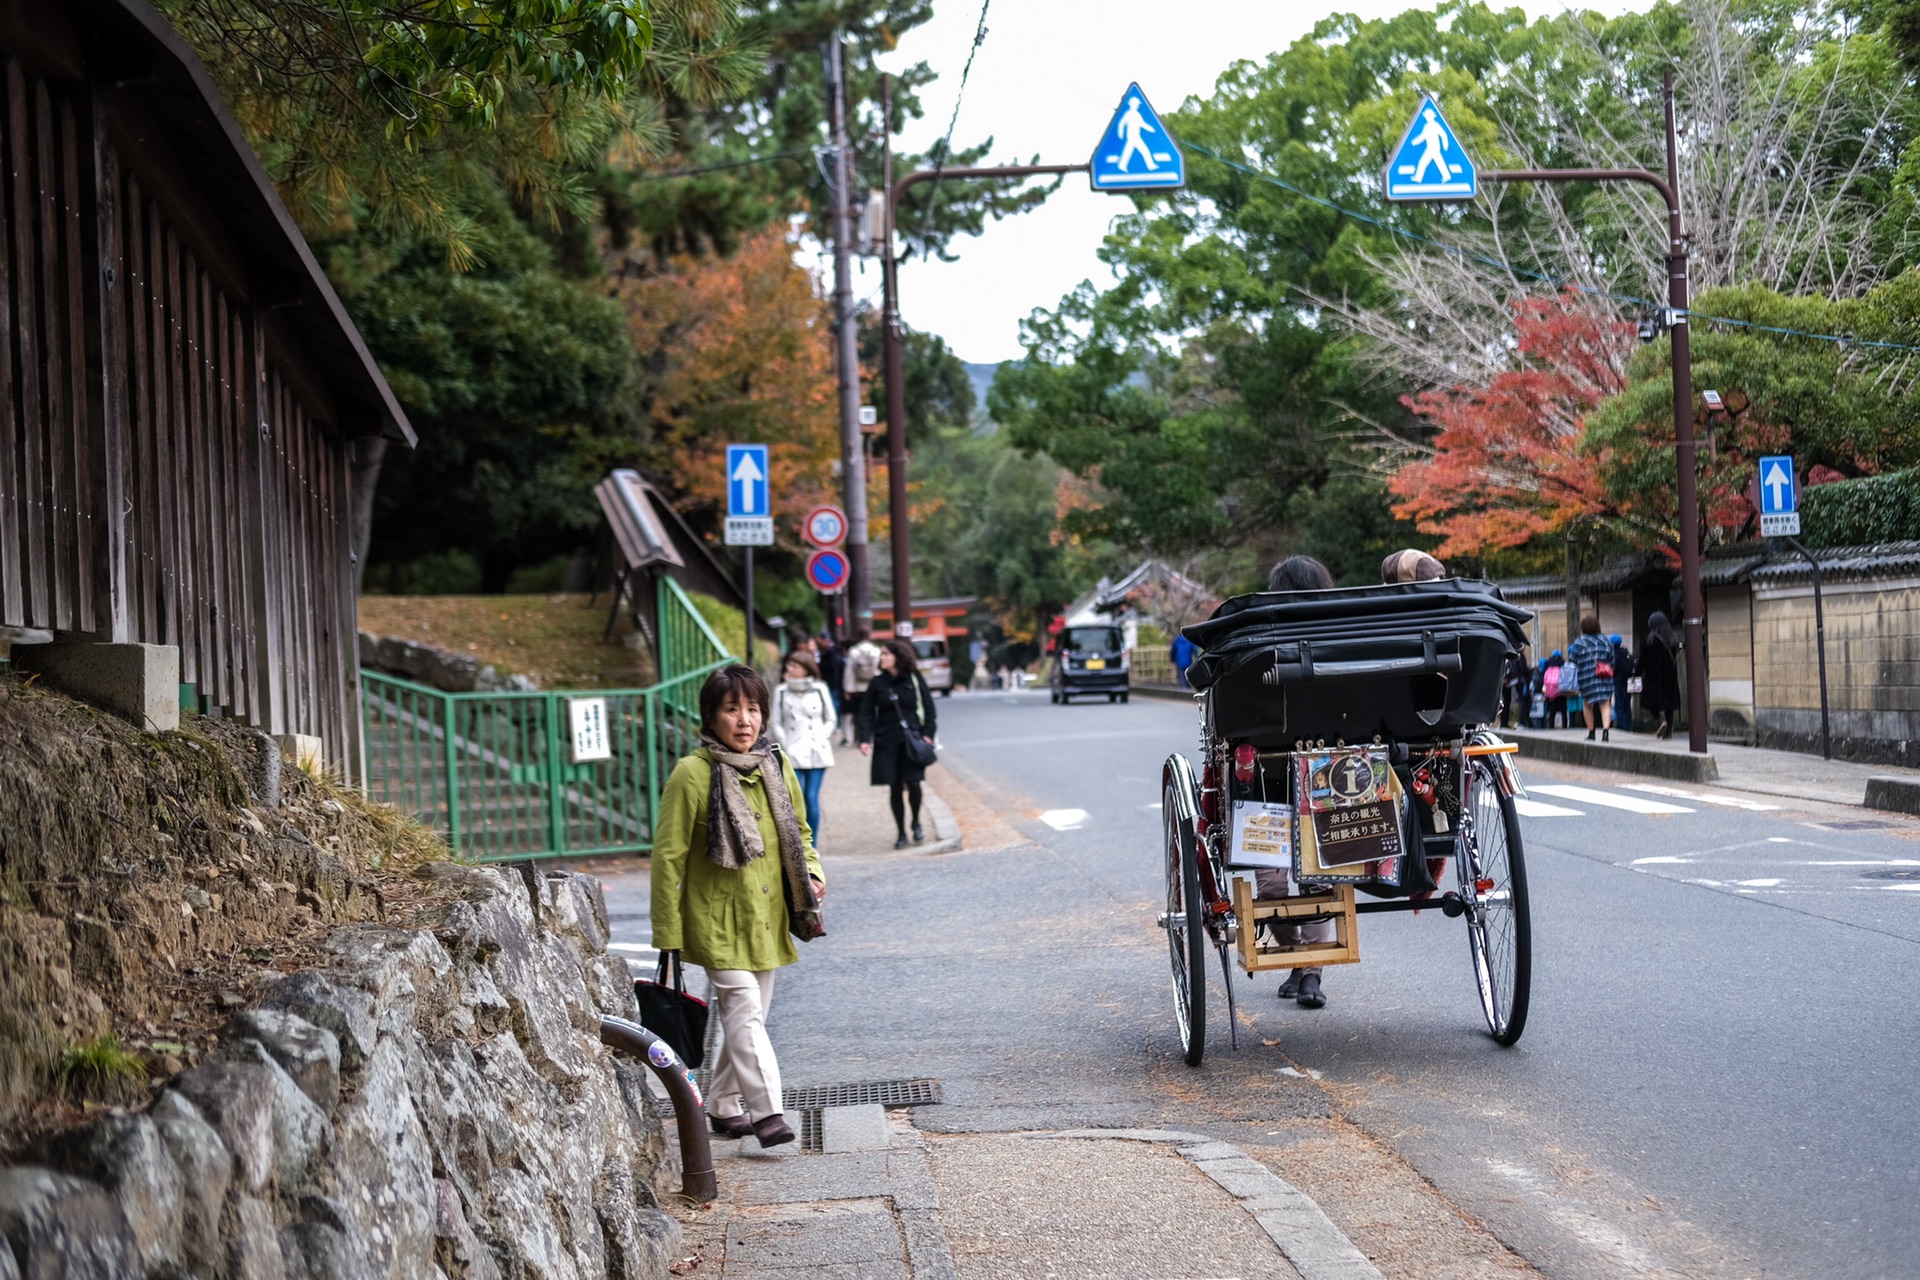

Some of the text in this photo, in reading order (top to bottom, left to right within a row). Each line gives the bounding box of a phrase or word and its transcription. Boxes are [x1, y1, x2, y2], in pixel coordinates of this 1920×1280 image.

[815, 518, 839, 537] 30
[1329, 806, 1381, 824] 奈良の観光
[1321, 821, 1395, 842] ご相談承ります。
